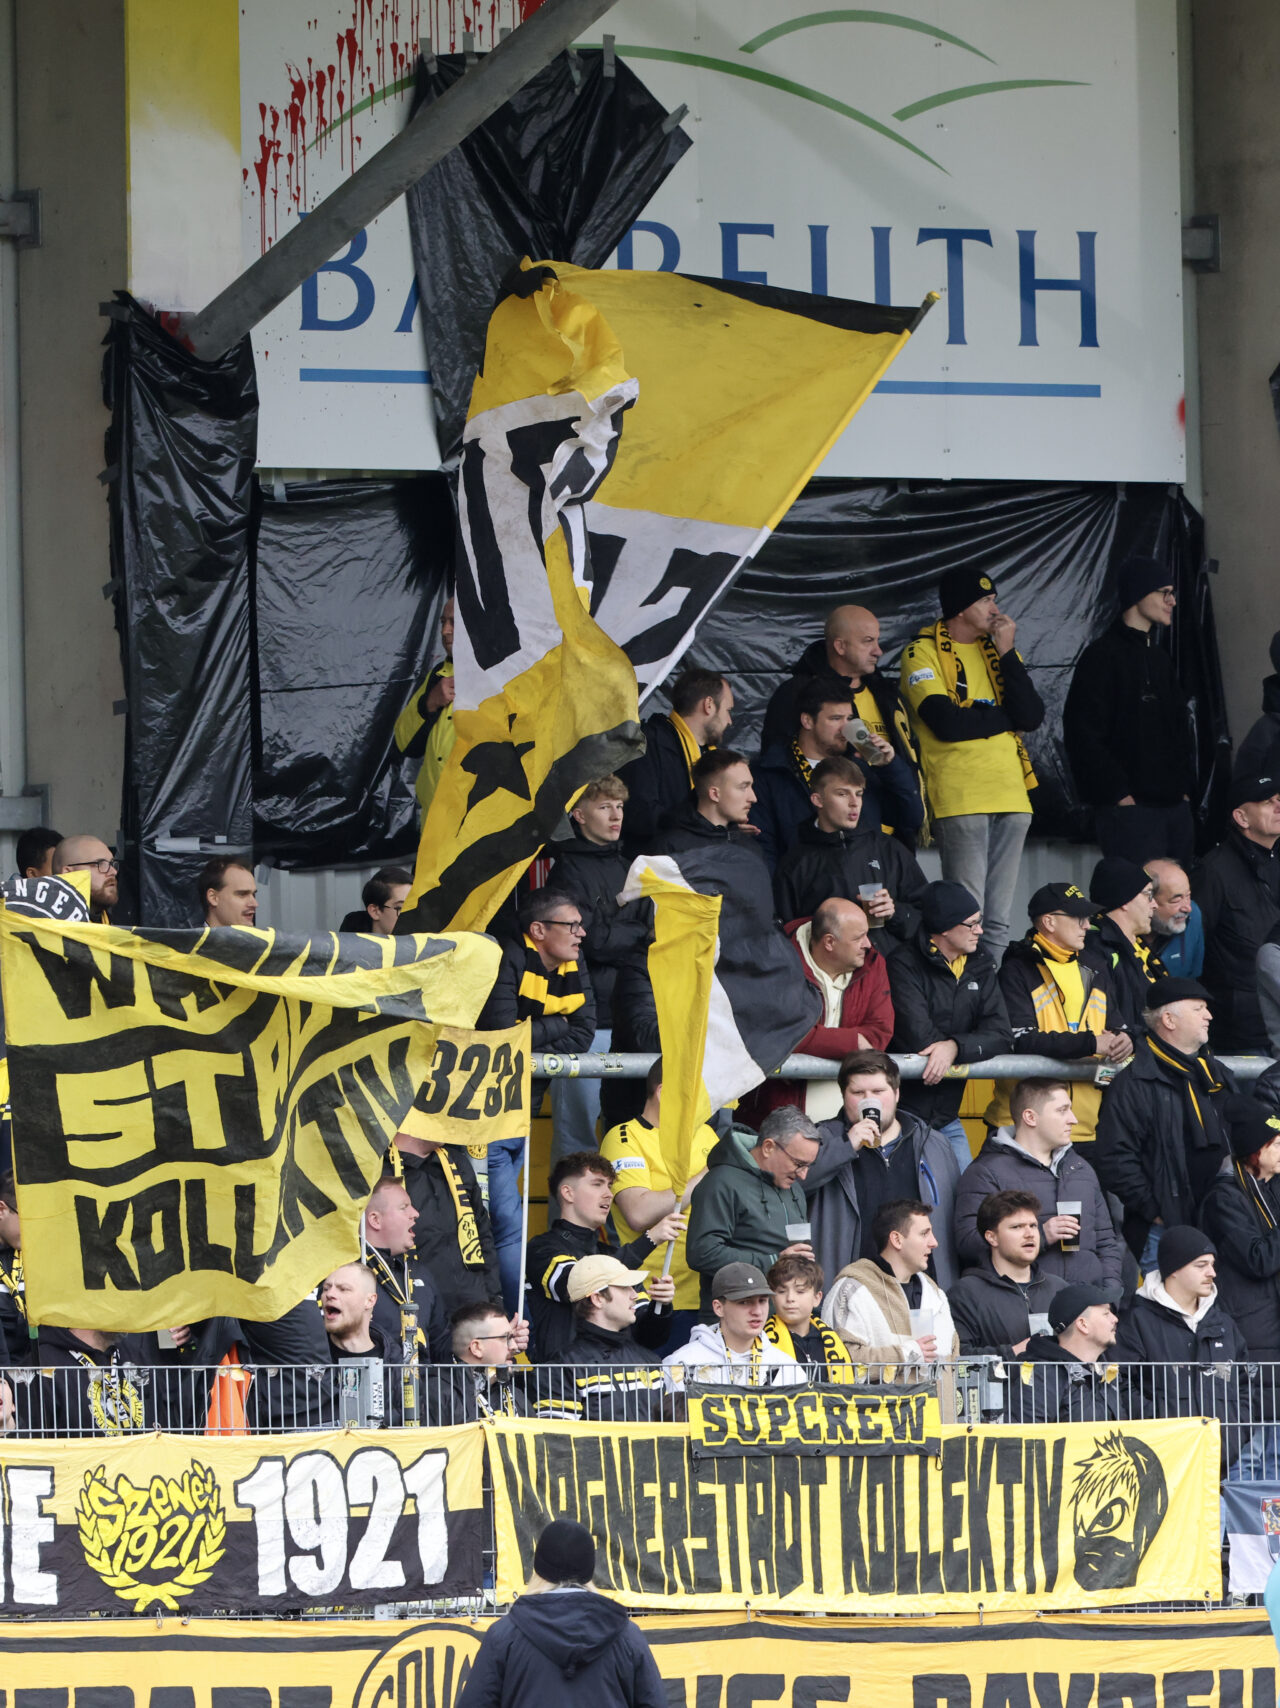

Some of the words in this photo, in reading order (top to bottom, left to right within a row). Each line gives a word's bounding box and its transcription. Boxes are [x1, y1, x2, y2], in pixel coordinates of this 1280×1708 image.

[297, 210, 1101, 350] BEUTH
[73, 1035, 414, 1293] KOLLKTIV
[700, 1392, 928, 1446] SUPCREW
[112, 1514, 207, 1576] 1921
[234, 1448, 450, 1597] 1921
[840, 1435, 1066, 1596] KOLLEKTIV
